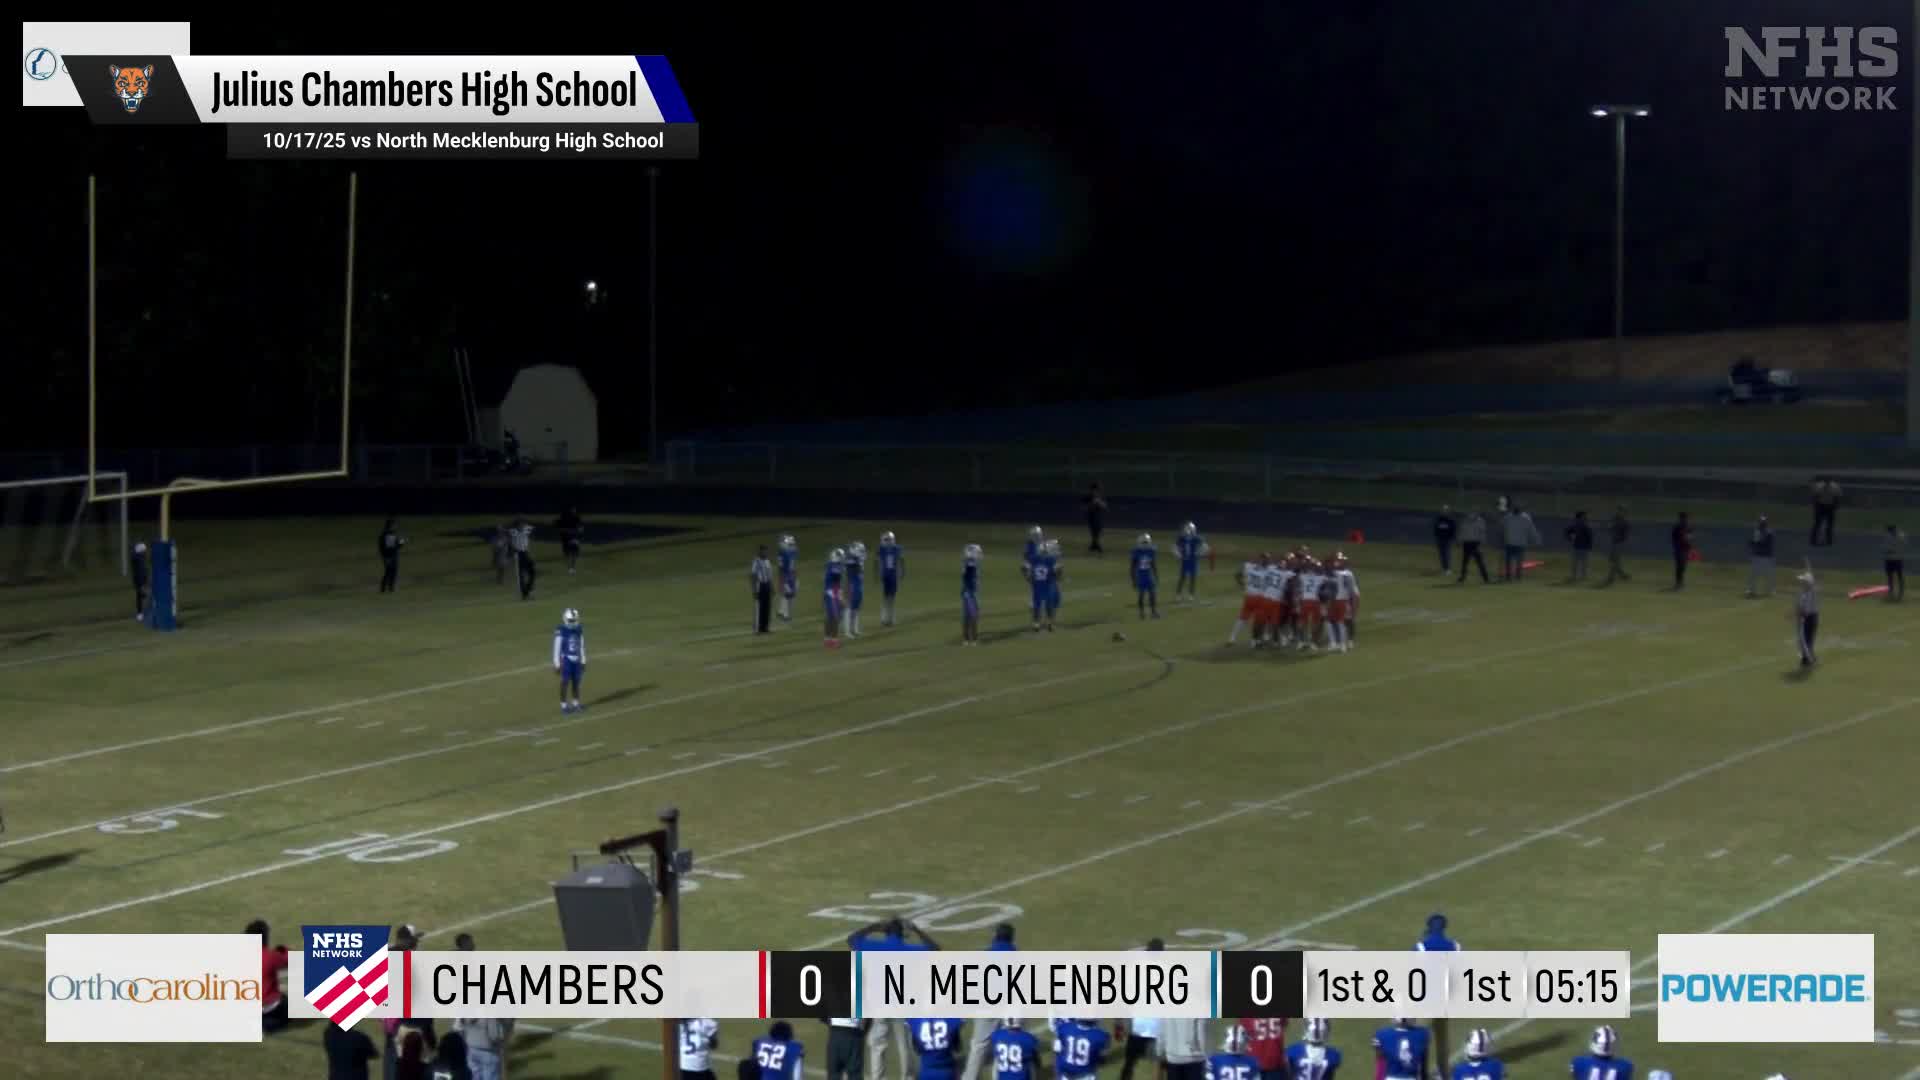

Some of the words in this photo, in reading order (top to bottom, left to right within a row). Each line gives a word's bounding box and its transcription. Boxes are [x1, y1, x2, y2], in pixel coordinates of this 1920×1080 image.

[920, 1021, 948, 1050] 42
[757, 1043, 786, 1070] 52
[1066, 1035, 1090, 1067] 19
